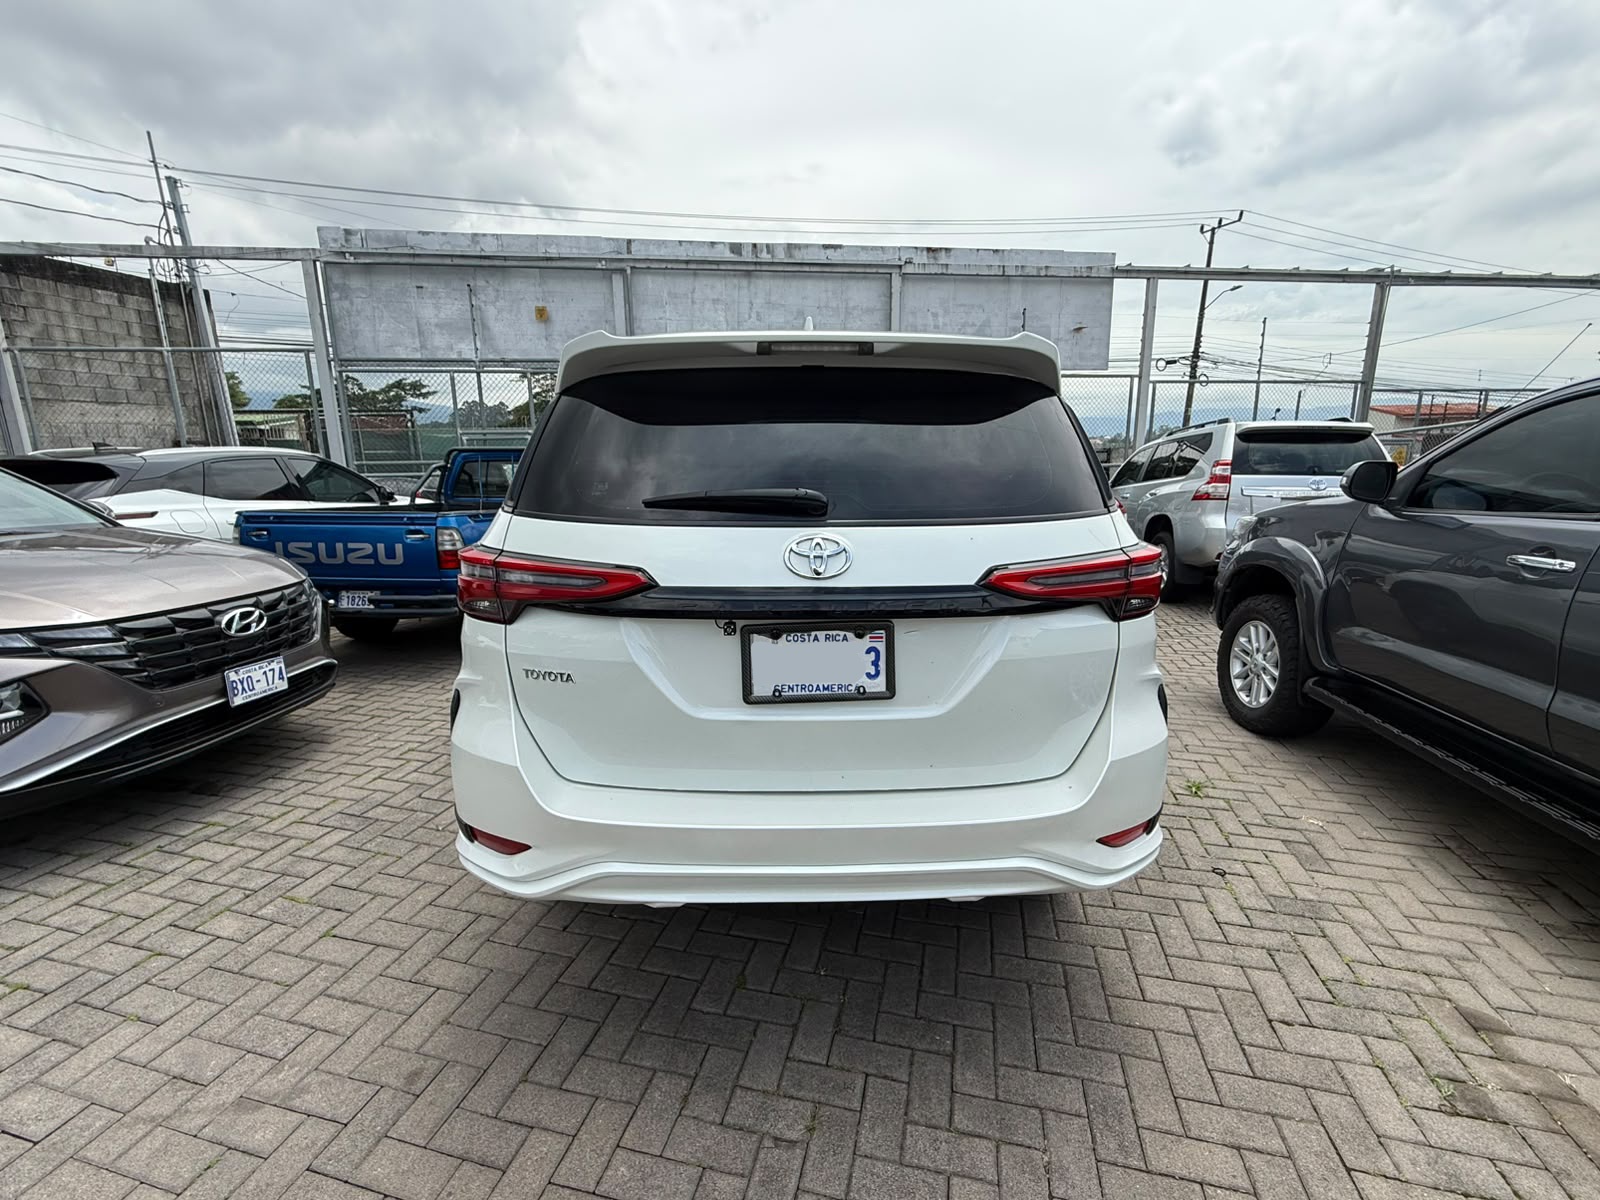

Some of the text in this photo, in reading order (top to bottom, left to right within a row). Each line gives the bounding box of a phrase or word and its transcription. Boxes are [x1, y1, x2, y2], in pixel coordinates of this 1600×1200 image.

[275, 541, 404, 565] ISUZU
[346, 595, 370, 607] 1826
[785, 633, 849, 643] COSTA RICA
[522, 668, 576, 684] TOYOTA
